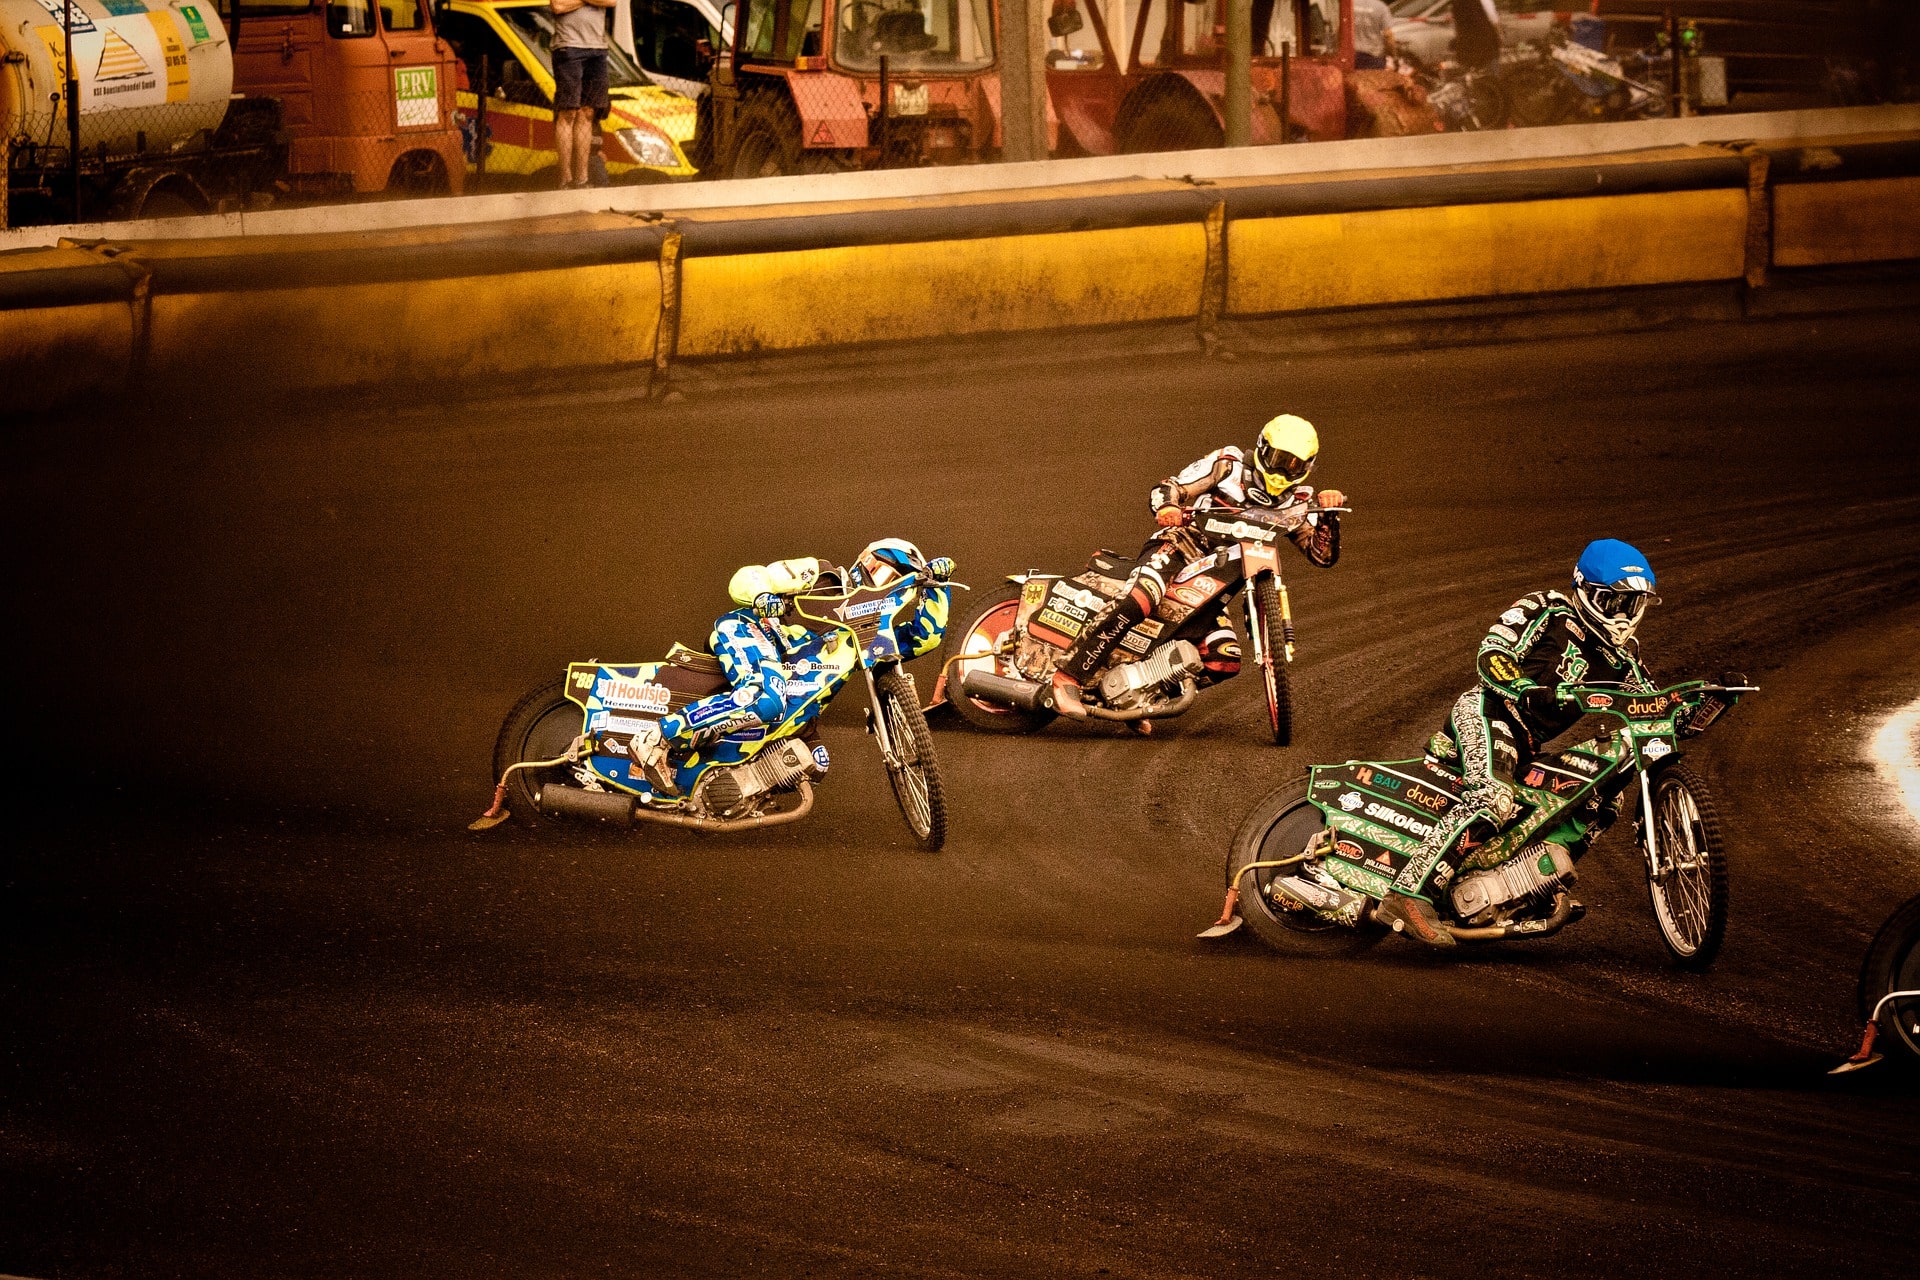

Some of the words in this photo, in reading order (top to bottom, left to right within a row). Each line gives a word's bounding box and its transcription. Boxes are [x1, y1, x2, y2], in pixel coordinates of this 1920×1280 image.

[400, 71, 432, 97] ERV
[1042, 610, 1080, 631] KLUWE
[810, 662, 841, 671] Bosma
[571, 671, 596, 689] #88
[617, 682, 670, 705] Houtsje
[604, 700, 667, 713] Heerenveen
[1589, 696, 1611, 706] BMC
[1627, 698, 1663, 714] druck
[713, 713, 757, 734] HOUTTEC
[1643, 746, 1670, 754] FUCHS
[1372, 773, 1402, 790] BAU
[1340, 795, 1363, 807] FUCHS
[1406, 784, 1440, 811] druck
[1338, 842, 1362, 858] BMC
